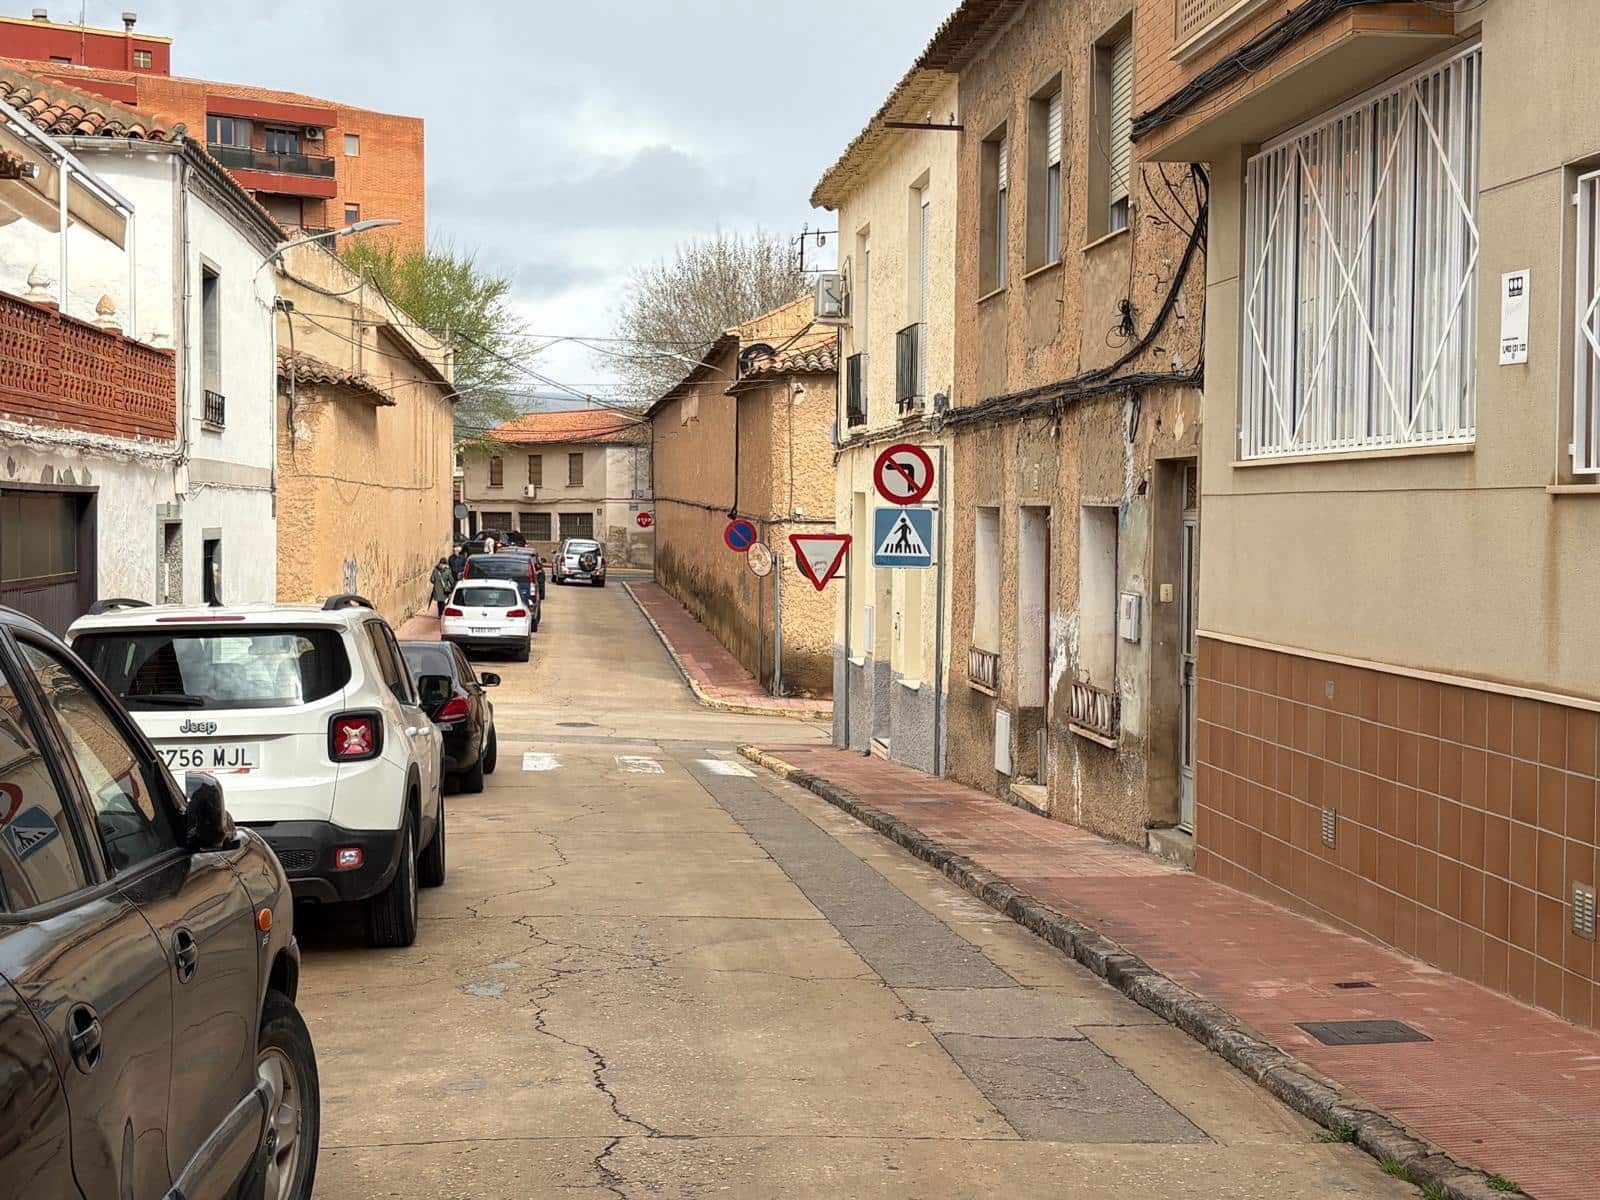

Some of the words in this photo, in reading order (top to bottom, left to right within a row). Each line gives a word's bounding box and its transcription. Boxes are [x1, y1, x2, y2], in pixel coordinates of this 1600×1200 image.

[180, 719, 217, 735] Jeep
[157, 749, 204, 767] 756
[213, 748, 253, 767] MJL
